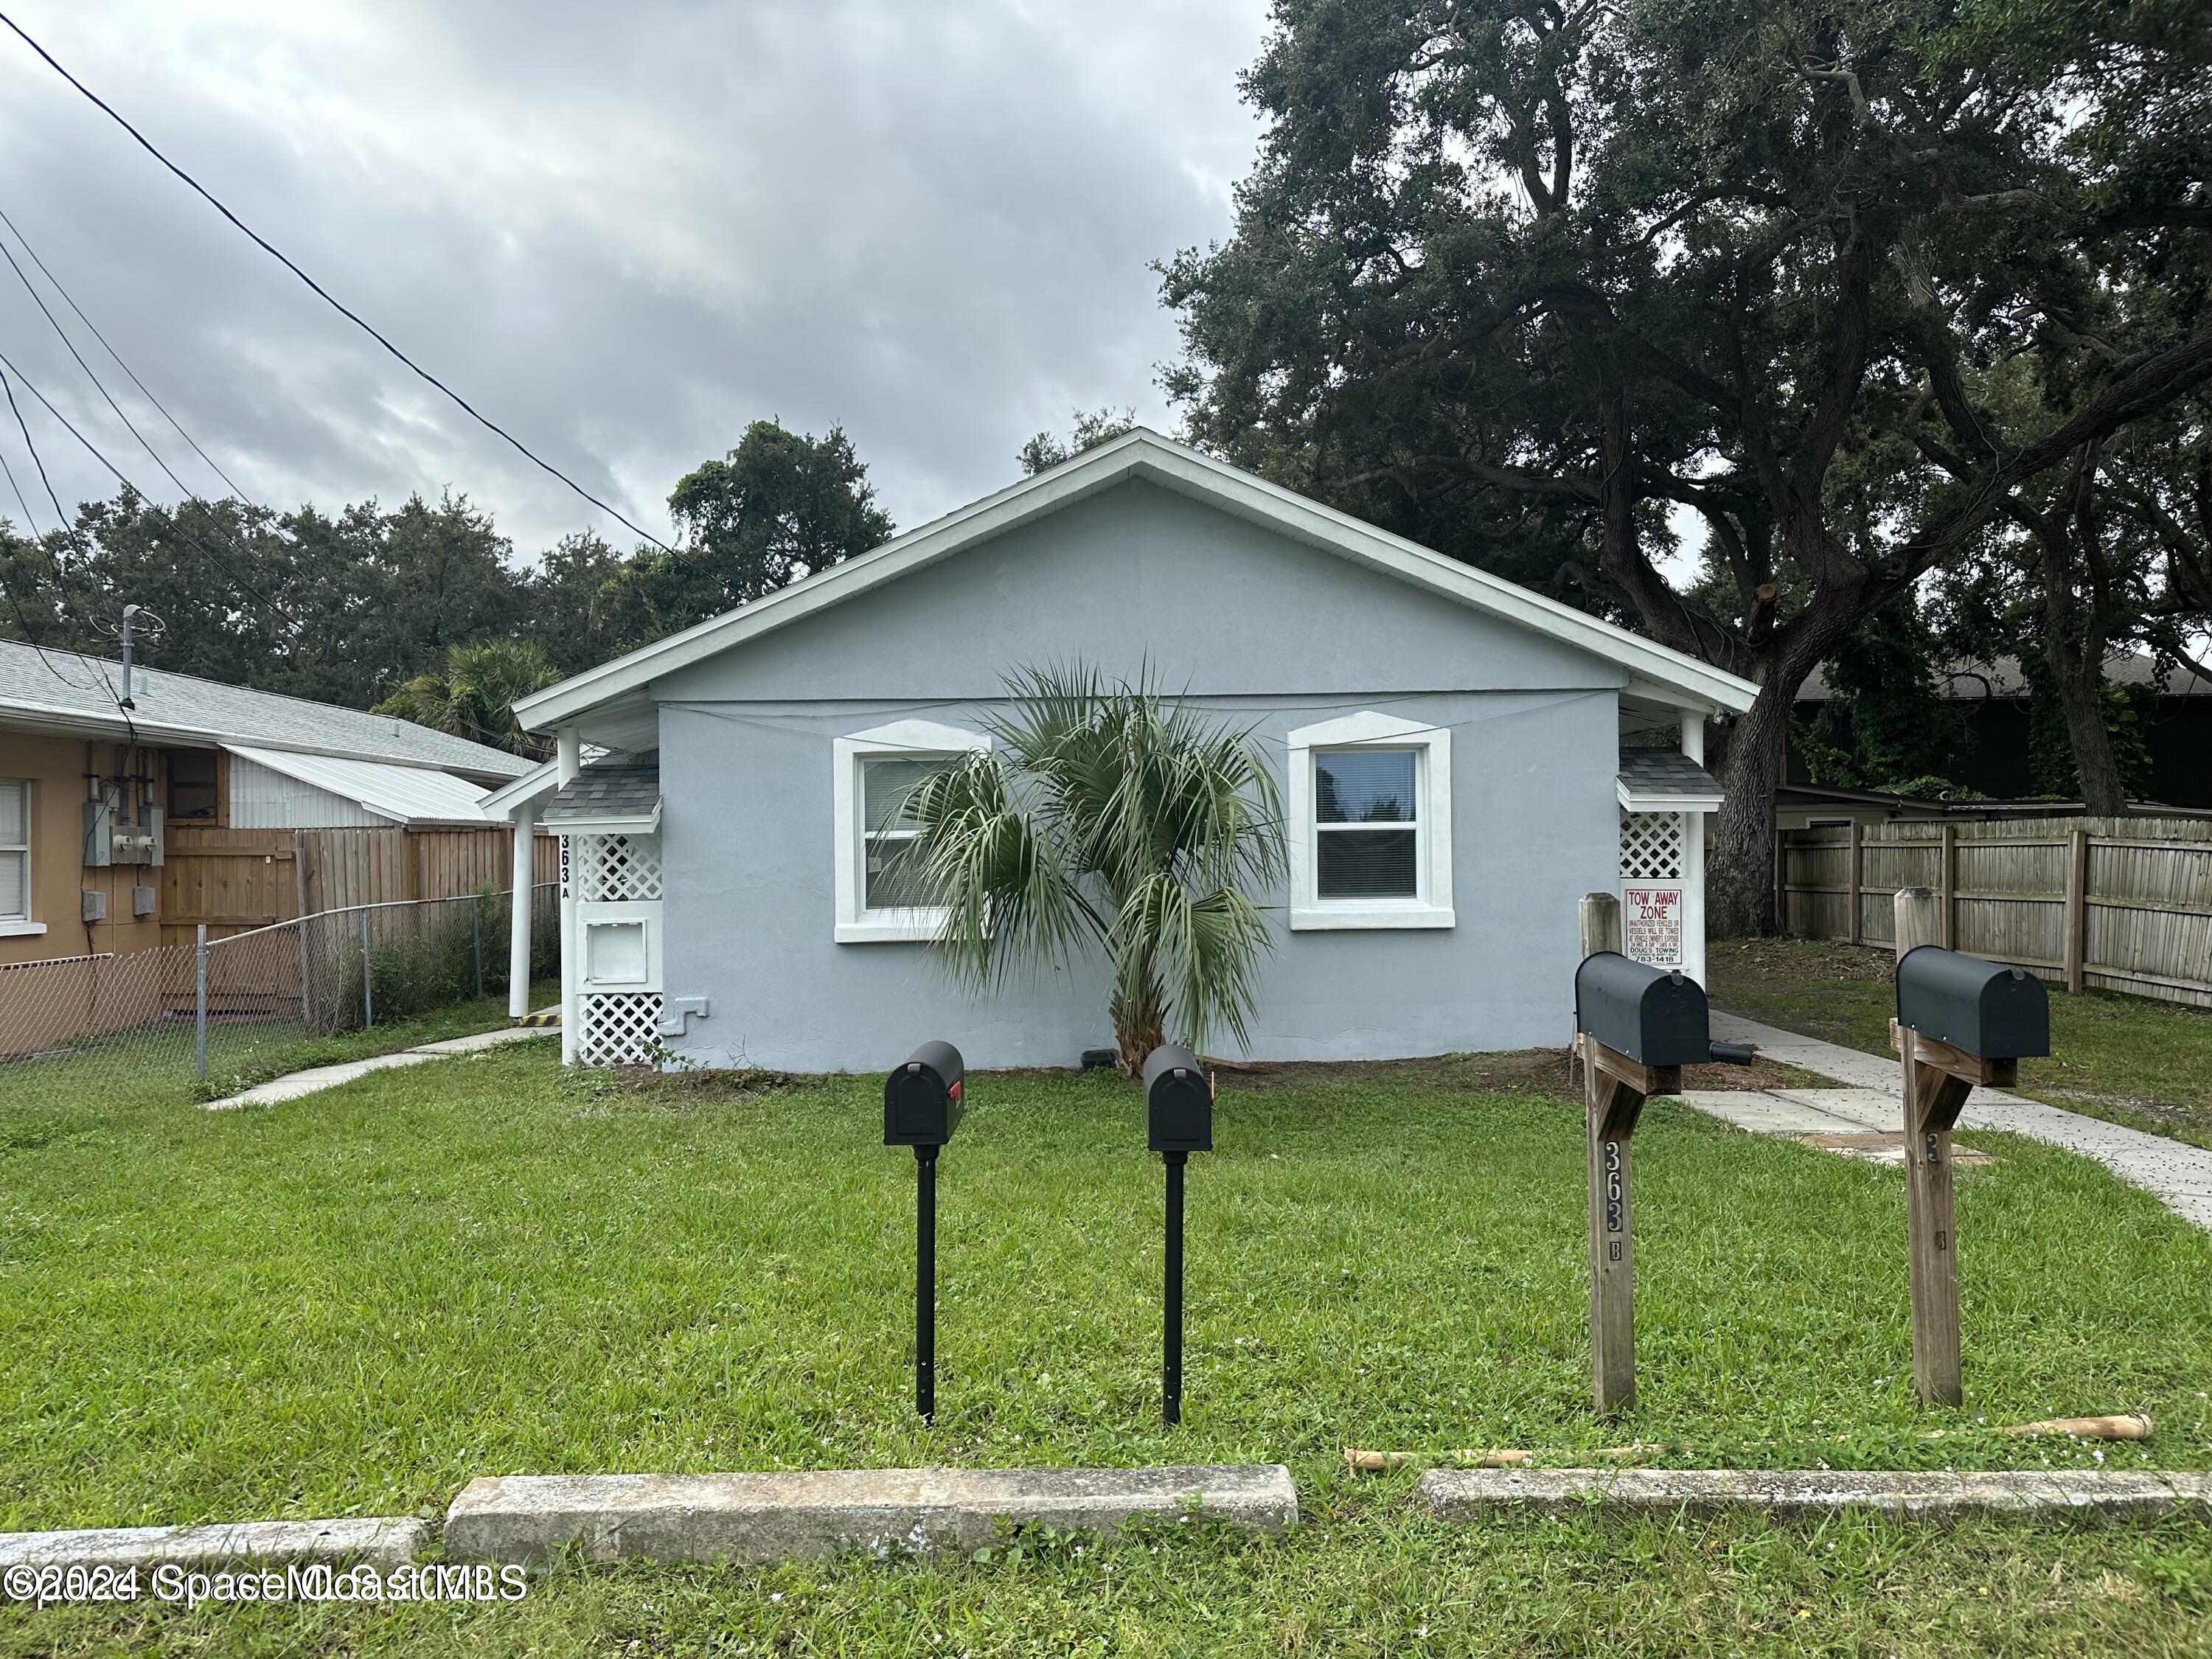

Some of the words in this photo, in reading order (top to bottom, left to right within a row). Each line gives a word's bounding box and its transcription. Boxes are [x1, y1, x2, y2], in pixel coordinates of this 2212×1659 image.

[563, 888, 569, 898] A
[1629, 892, 1649, 905] TOW
[1655, 892, 1678, 905] AWAY
[1641, 906, 1667, 919] ZONE
[1606, 1142, 1622, 1231] 363
[1611, 1242, 1621, 1260] B
